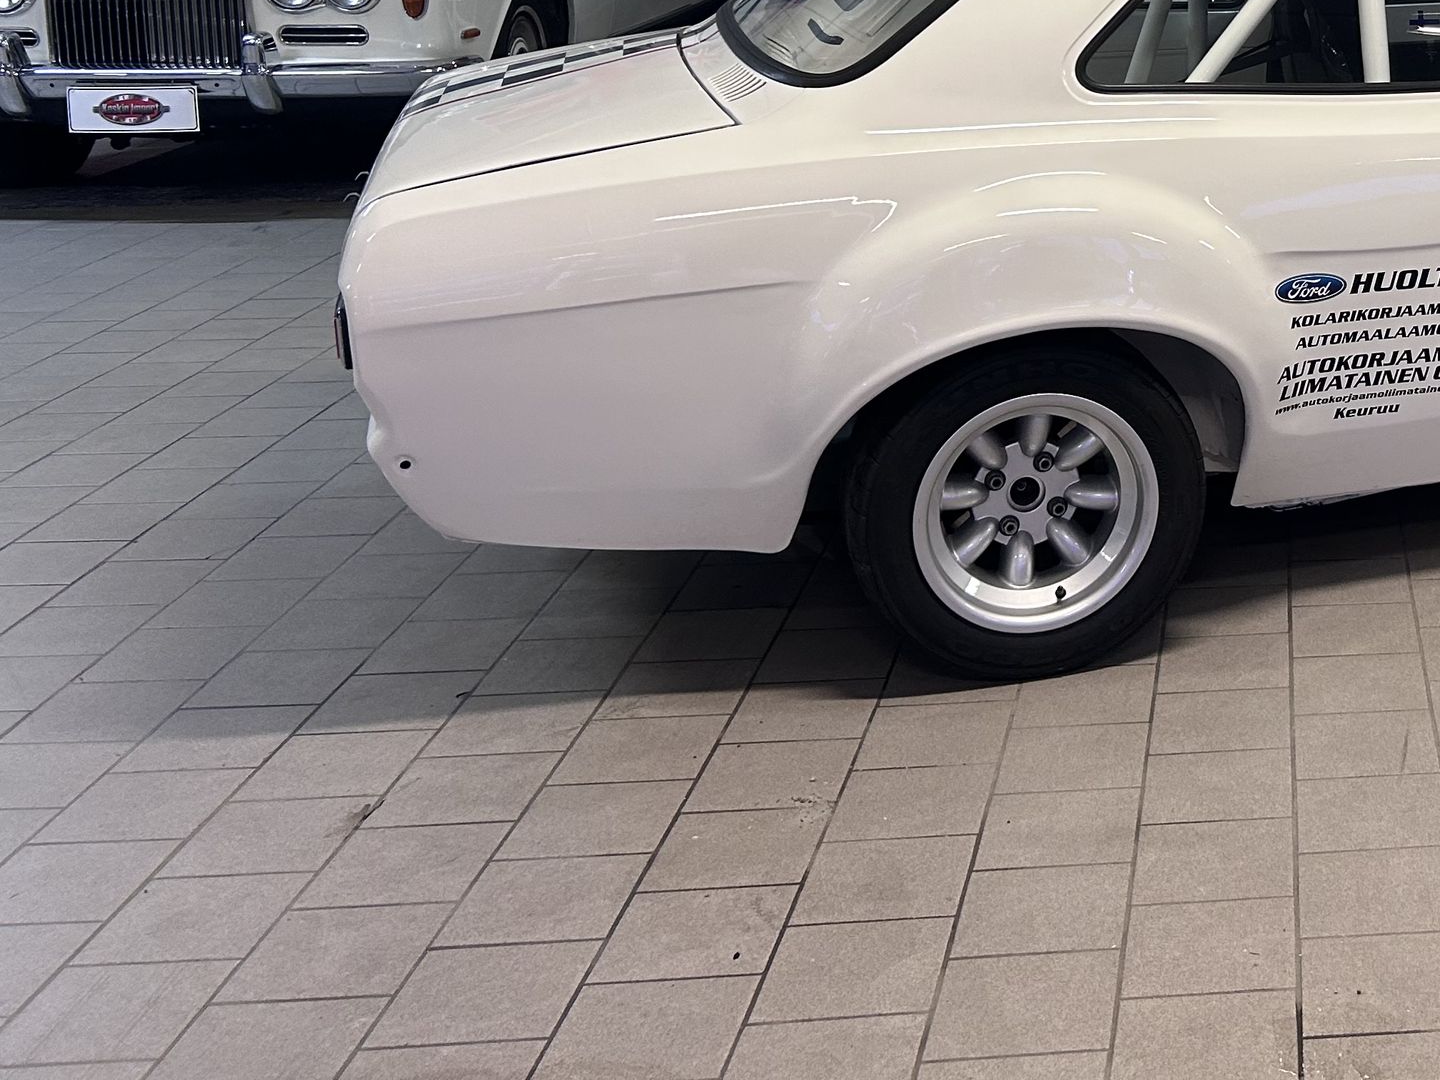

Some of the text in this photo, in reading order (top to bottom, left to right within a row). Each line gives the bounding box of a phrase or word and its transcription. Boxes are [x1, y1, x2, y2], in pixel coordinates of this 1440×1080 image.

[1287, 278, 1331, 300] Ford
[1279, 366, 1430, 402] LIIMATAINEN
[1333, 403, 1400, 420] Keuruu
